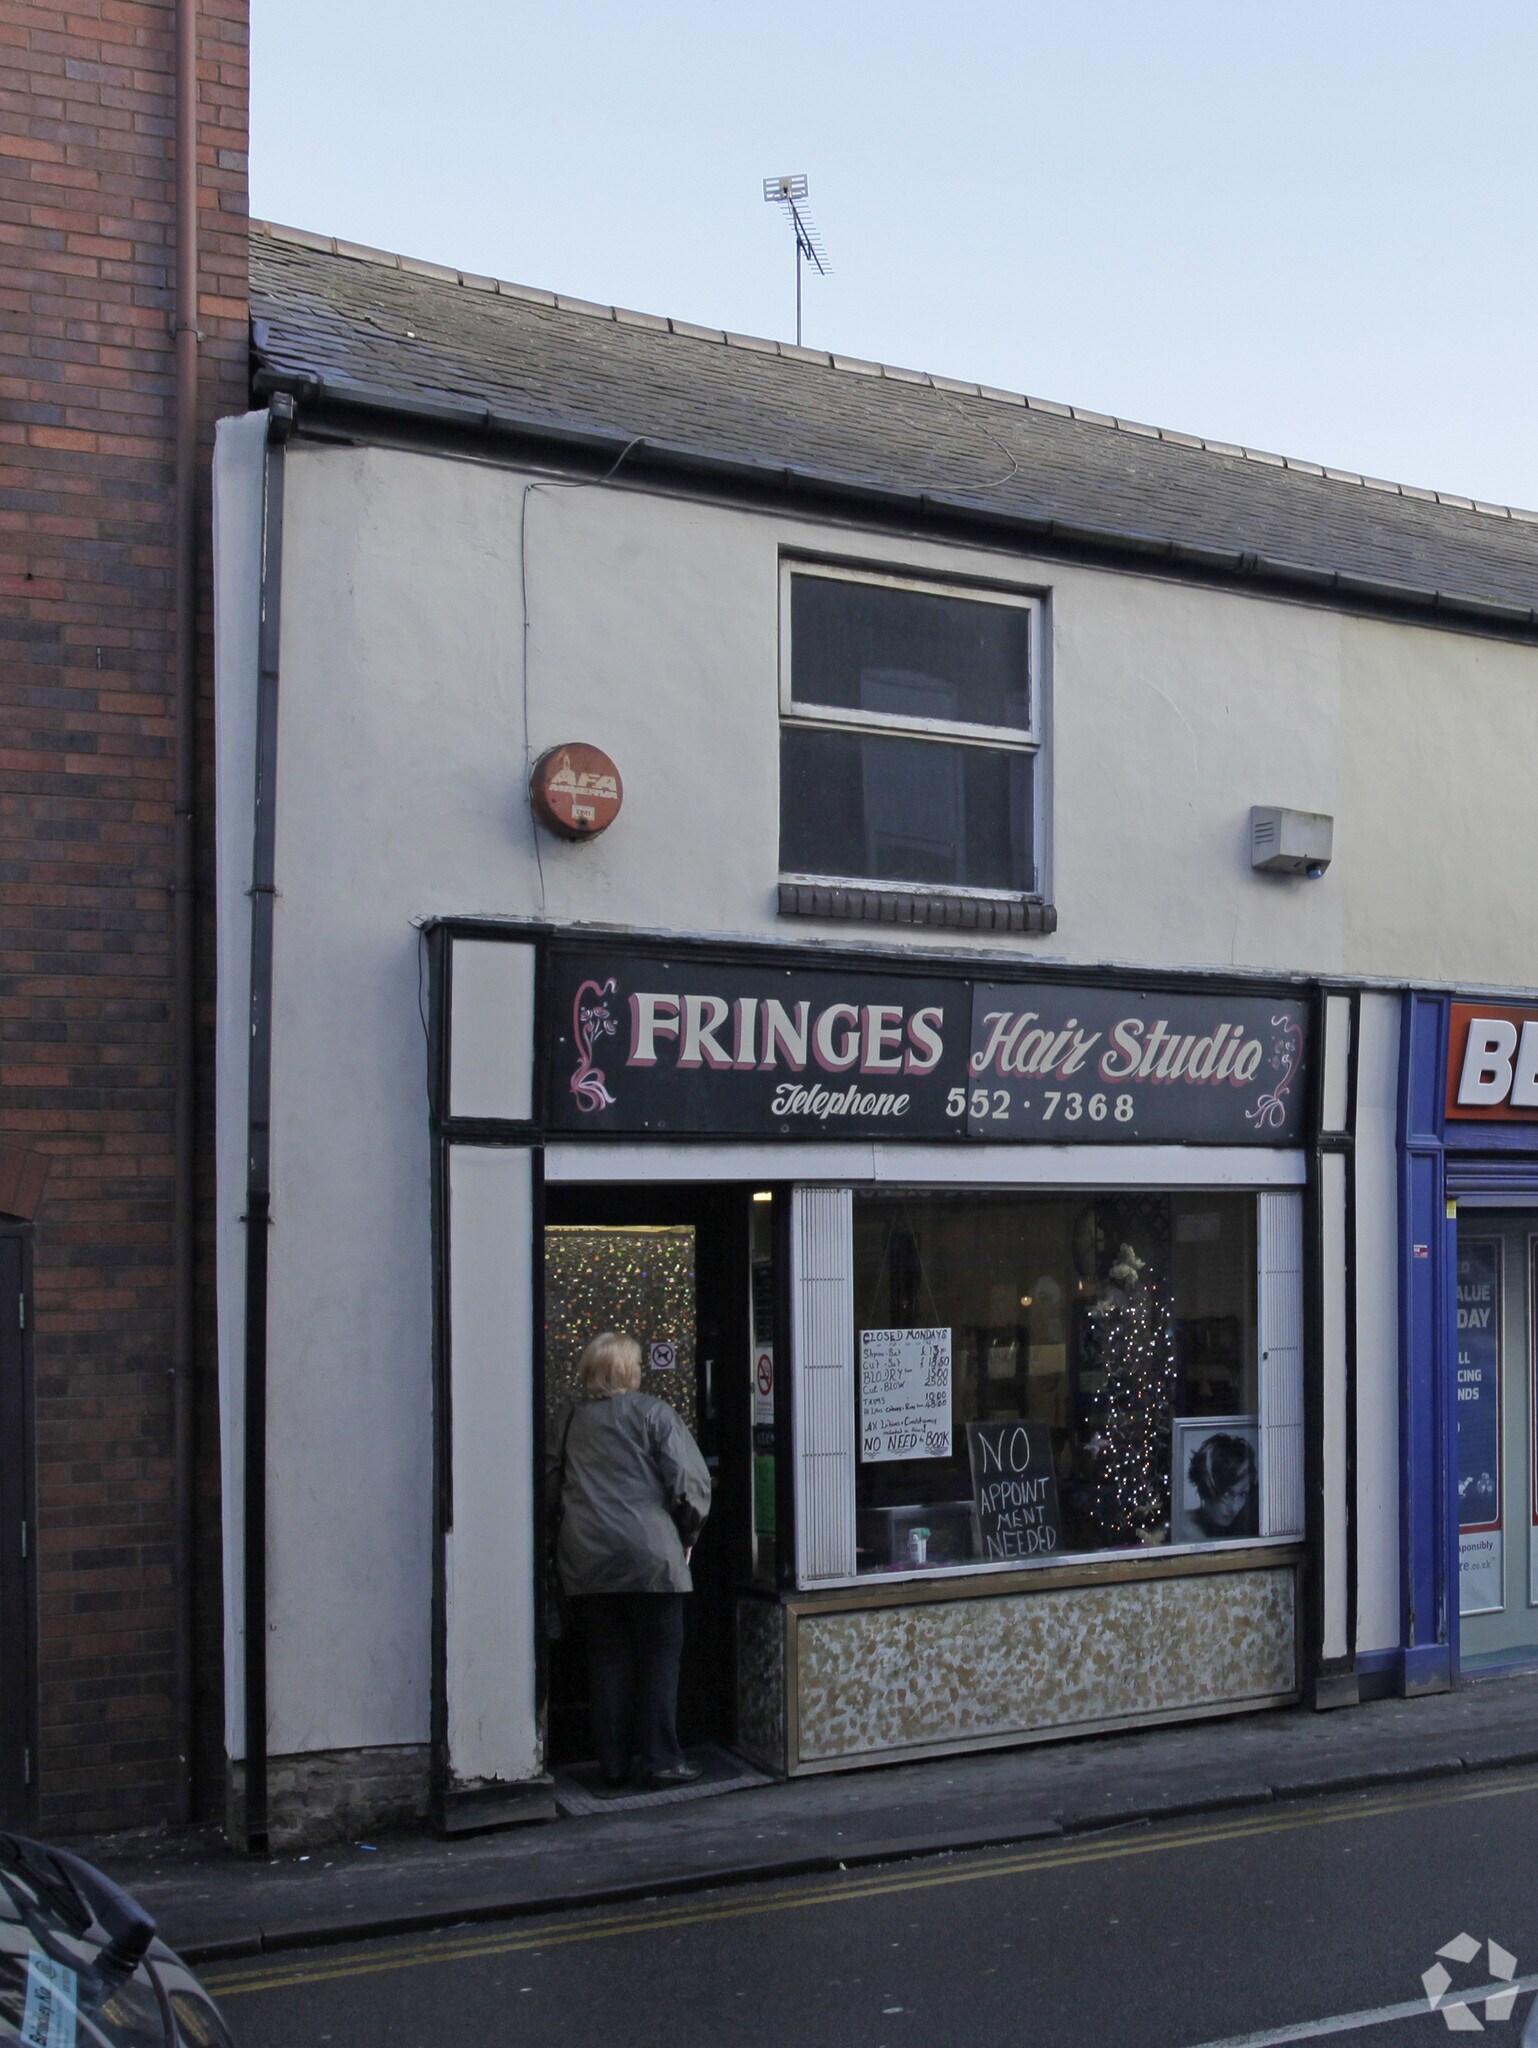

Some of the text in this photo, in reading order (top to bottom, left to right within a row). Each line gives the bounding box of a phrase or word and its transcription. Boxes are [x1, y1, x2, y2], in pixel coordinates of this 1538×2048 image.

[627, 992, 1264, 1085] FRINGES Hair Studio
[1457, 1017, 1538, 1106] BE
[771, 1083, 910, 1119] Telephone
[1457, 1284, 1491, 1302] ALUE
[863, 1329, 948, 1344] CLOSED MONDAYS
[1458, 1351, 1471, 1365] LL
[1457, 1369, 1482, 1383] CING
[1457, 1387, 1480, 1401] NDS
[863, 1436, 882, 1451] NO
[887, 1433, 918, 1449] NEED
[925, 1431, 950, 1448] BOOK
[978, 1427, 1030, 1473] NO
[981, 1474, 1050, 1515] APPOINT
[997, 1506, 1045, 1531] MENT
[987, 1526, 1056, 1561] NEEDED
